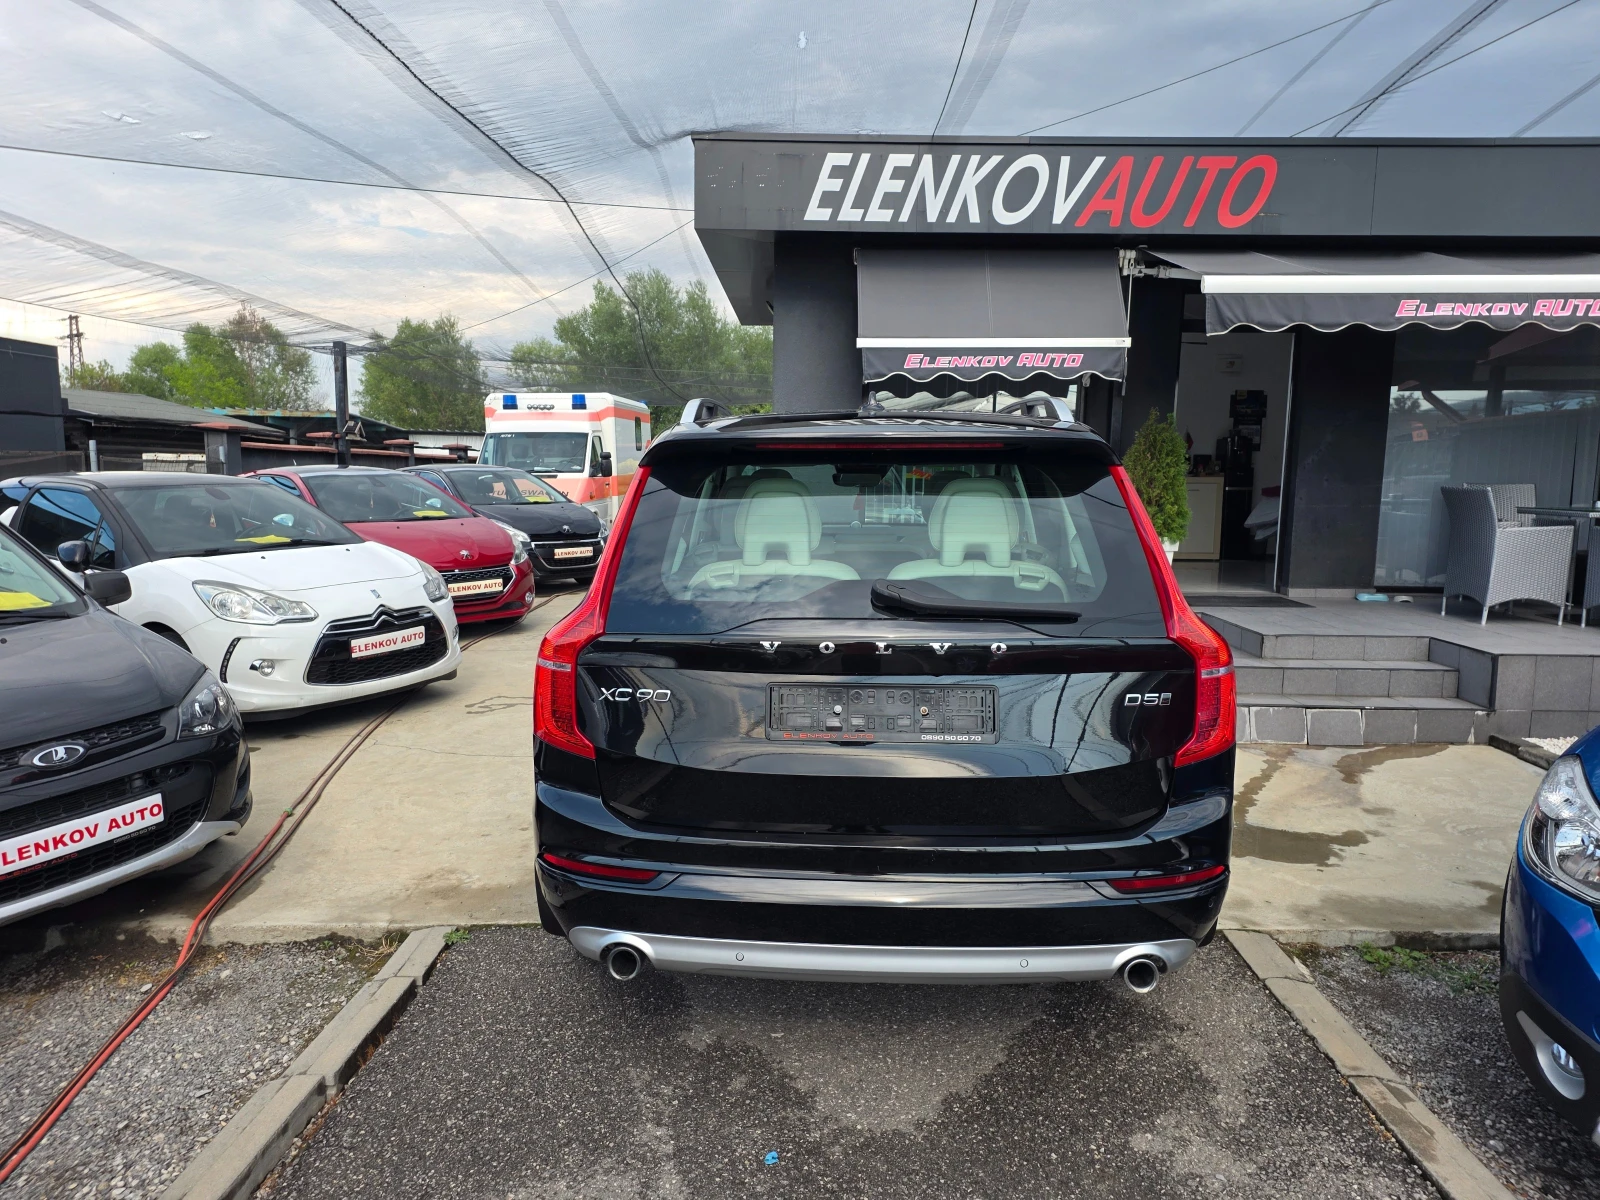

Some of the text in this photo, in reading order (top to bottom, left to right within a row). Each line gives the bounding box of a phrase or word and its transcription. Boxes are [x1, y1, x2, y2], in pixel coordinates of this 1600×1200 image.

[1395, 300, 1528, 317] ELENKOV
[904, 352, 1084, 368] ELENKOV AUTO
[448, 581, 503, 593] ELENKOV AUTO
[350, 631, 424, 654] ELENKOV AUTO
[759, 641, 1007, 655] VOLVO
[598, 687, 671, 703] XC 90
[783, 732, 874, 740] ELENKOV AUTO
[1, 803, 163, 867] LENKOV AUTO
